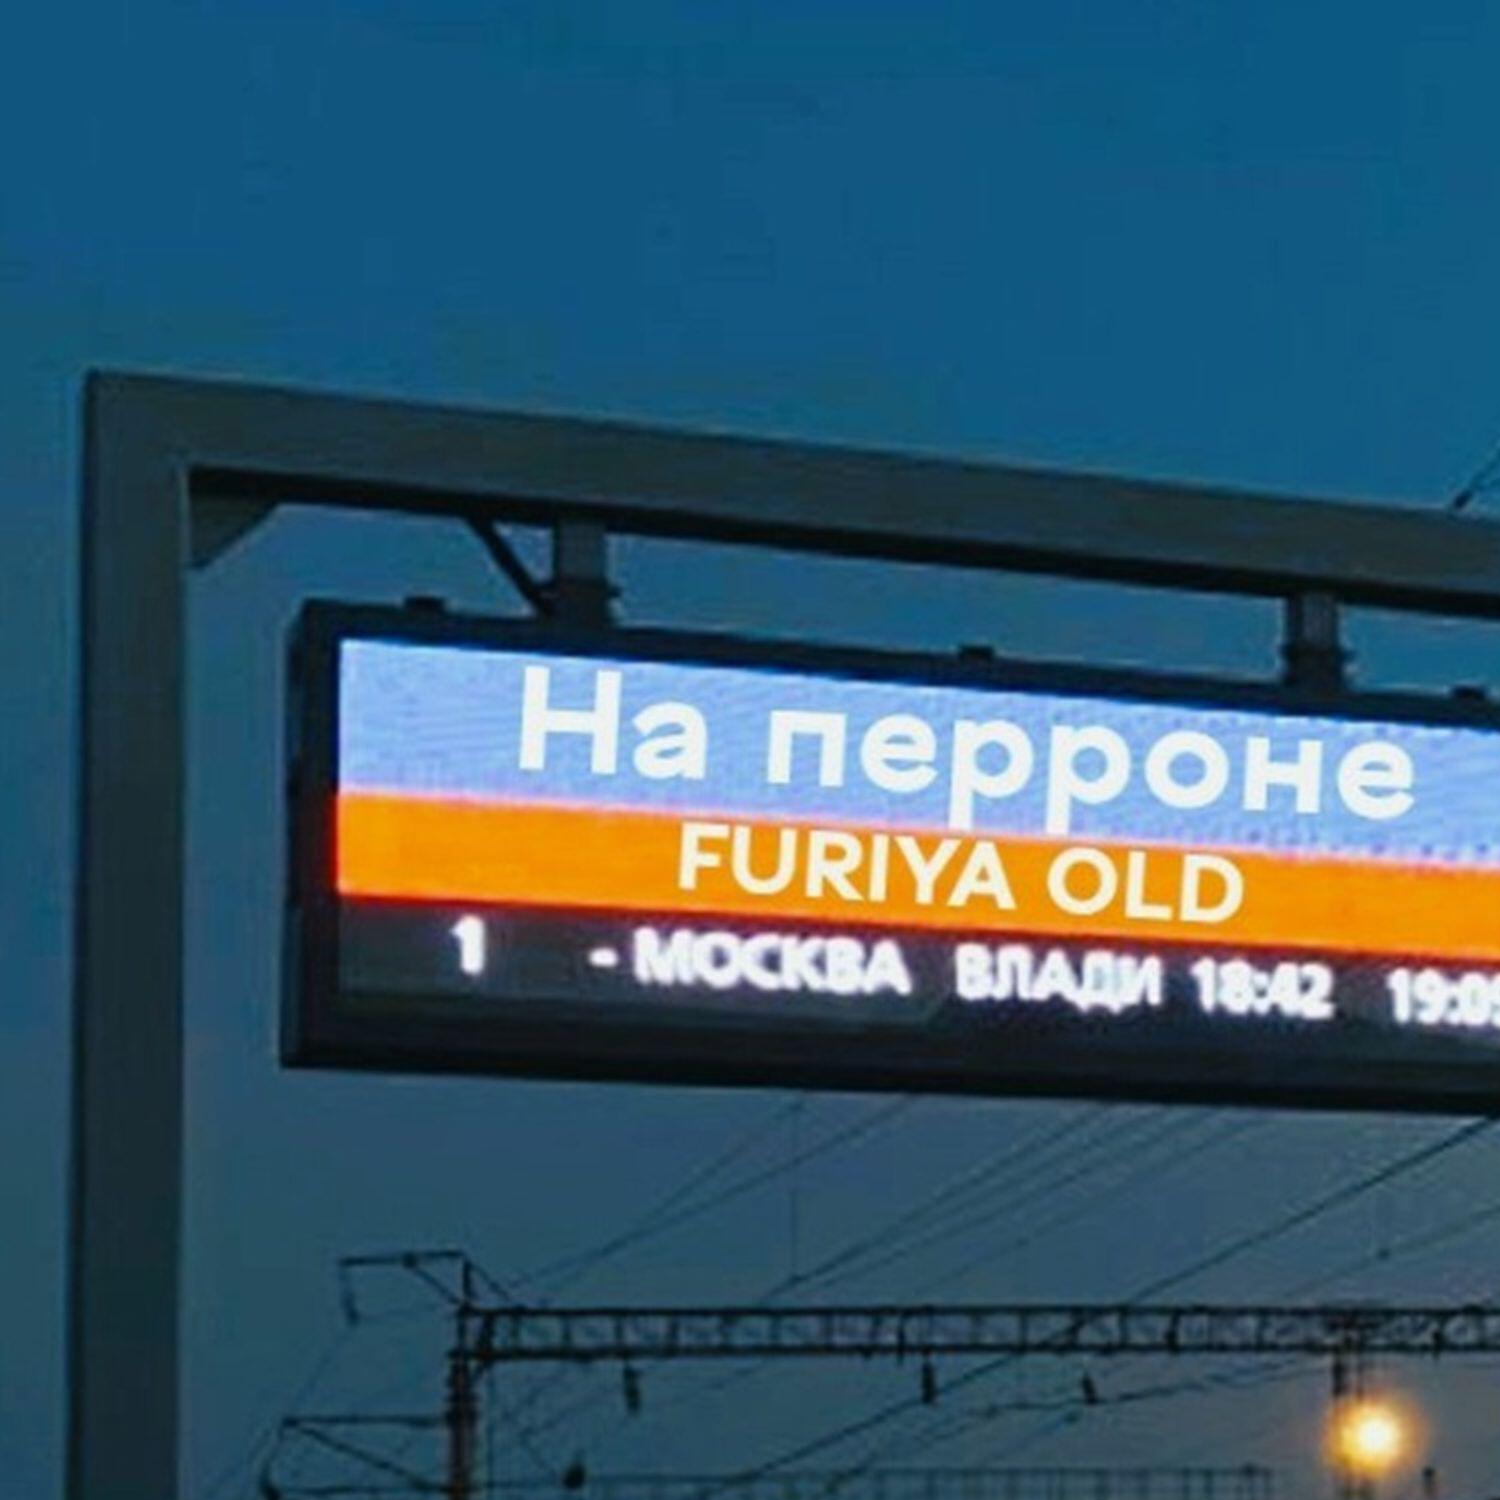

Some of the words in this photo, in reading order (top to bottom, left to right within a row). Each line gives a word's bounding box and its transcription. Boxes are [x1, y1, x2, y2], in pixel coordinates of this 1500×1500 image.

[520, 666, 708, 780] На
[766, 709, 1415, 834] перроне
[678, 822, 1016, 909] FURIYA
[1047, 846, 1244, 924] OLD
[450, 915, 486, 976] 1
[631, 926, 913, 995] МОСКВА
[954, 942, 1162, 1012] ВЛАДИ
[1190, 956, 1336, 1019] 18:42
